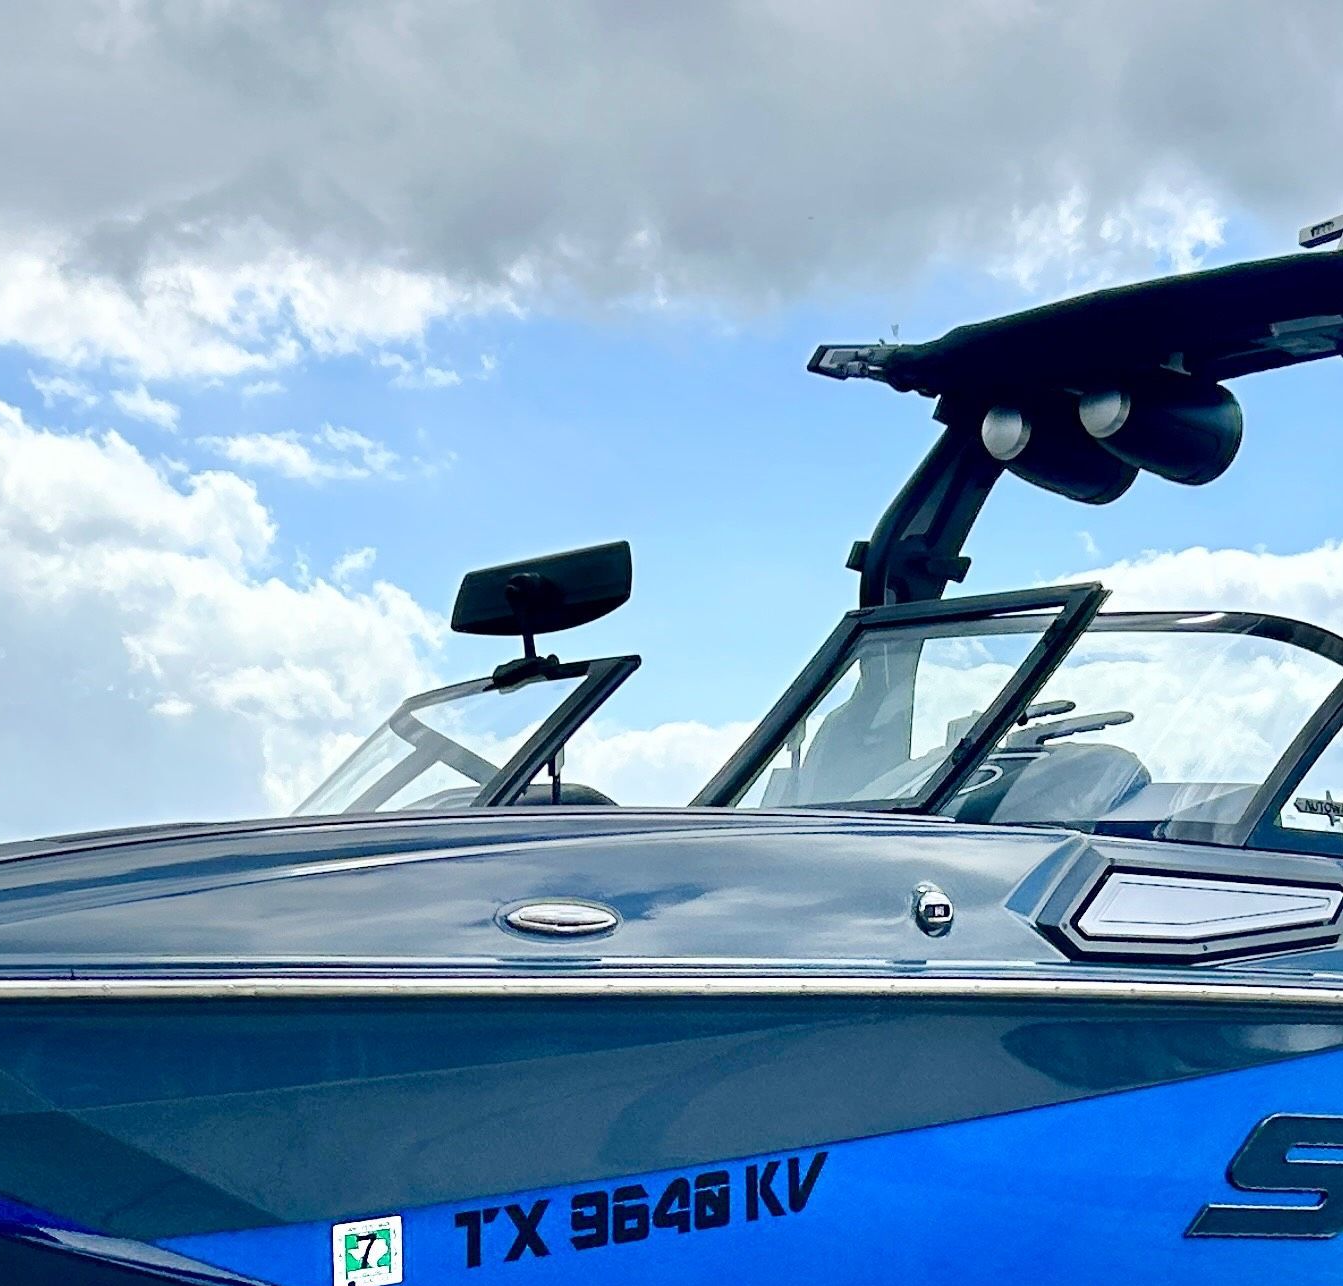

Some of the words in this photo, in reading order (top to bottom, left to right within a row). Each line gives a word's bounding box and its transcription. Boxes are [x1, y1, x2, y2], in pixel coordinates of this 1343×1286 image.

[455, 1199, 552, 1269] TX
[745, 1152, 829, 1222] KV
[356, 1232, 377, 1269] 7
